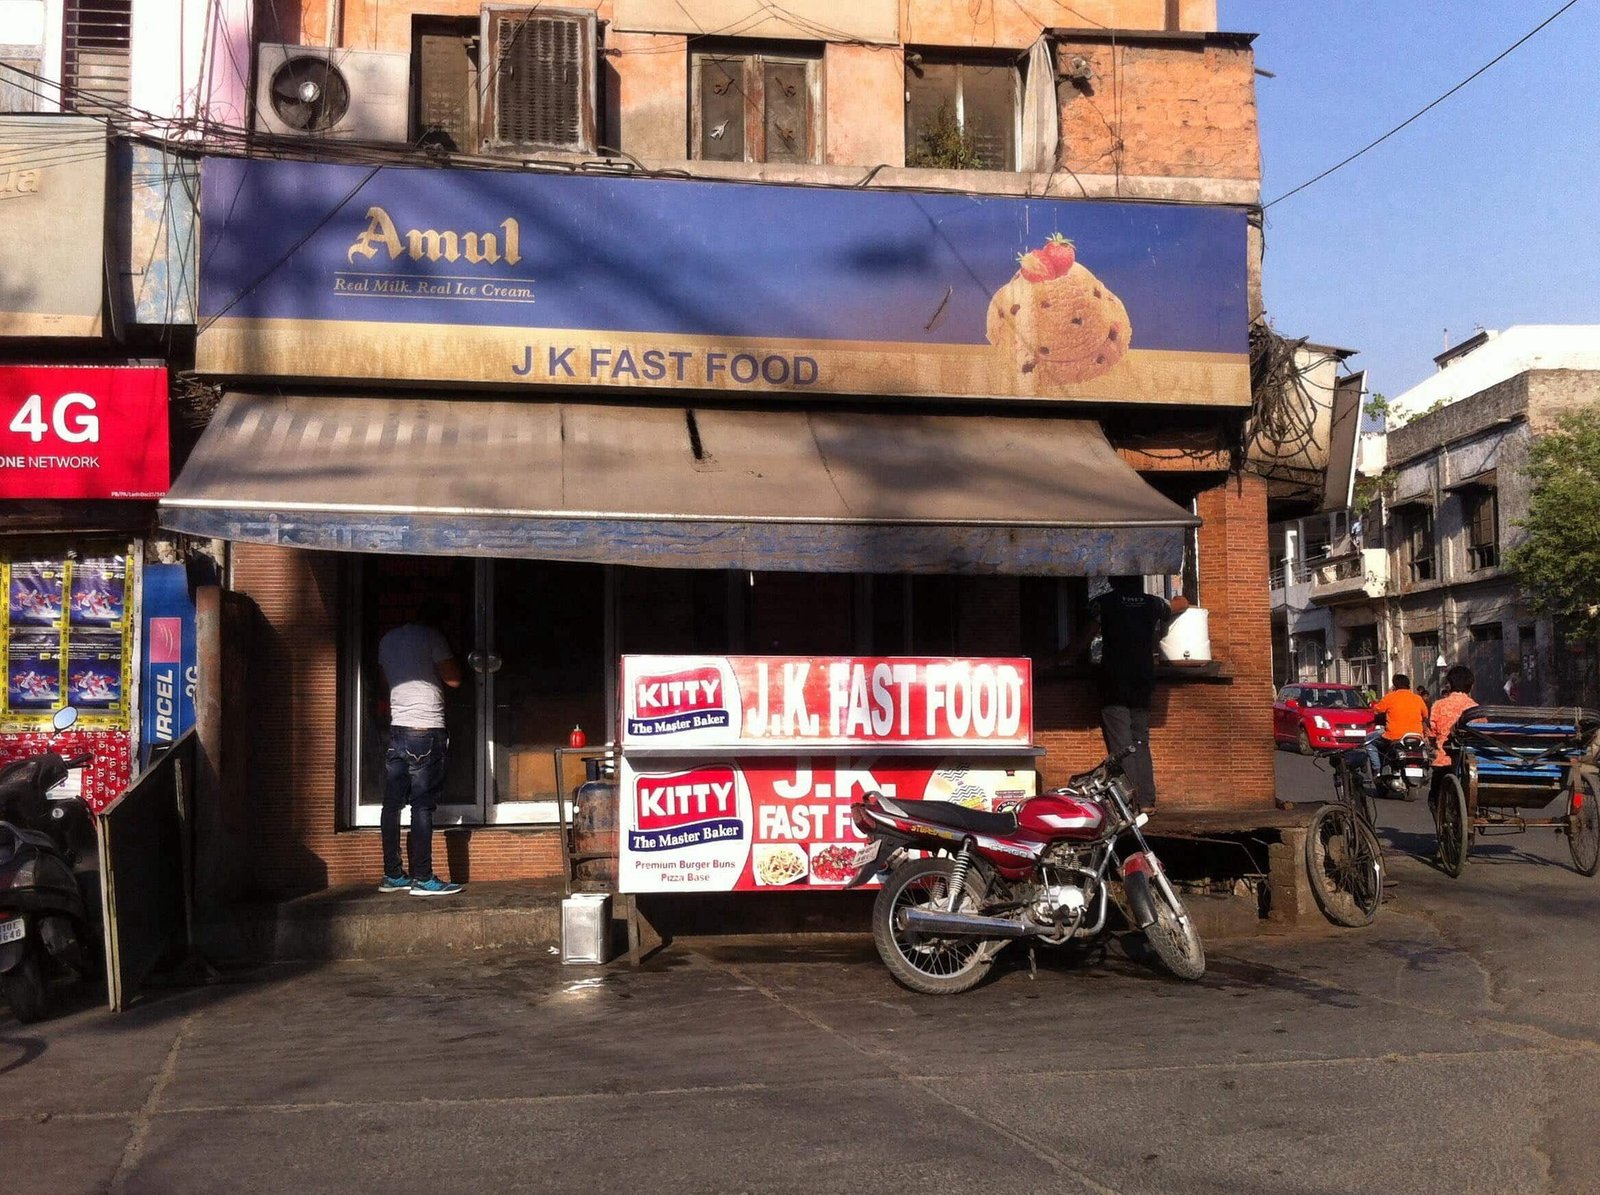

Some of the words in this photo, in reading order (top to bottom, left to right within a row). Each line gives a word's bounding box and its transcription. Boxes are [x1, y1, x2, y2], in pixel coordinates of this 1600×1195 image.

[348, 206, 522, 265] Amul
[333, 278, 369, 291] Real
[372, 279, 412, 292] Milk.
[416, 281, 451, 295] Real
[455, 283, 477, 295] Ice
[481, 284, 535, 298] Cream.
[512, 346, 532, 376] J
[549, 347, 576, 377] K
[590, 348, 692, 381] FAST
[706, 353, 819, 385] FOOD
[9, 392, 99, 443] 4G
[29, 456, 100, 468] NETWORK
[156, 669, 173, 750] IRCEL
[639, 679, 720, 708] KITTY
[746, 663, 820, 737] J.K.
[830, 663, 917, 737] FAST
[926, 661, 1023, 737] FOOD
[632, 722, 652, 735] The
[657, 717, 691, 733] Master
[693, 715, 726, 727] Baker
[640, 781, 733, 817] KITTY
[633, 835, 656, 849] The
[659, 830, 700, 847] Master
[703, 825, 739, 841] Baker
[759, 804, 830, 839] FAST
[635, 860, 677, 870] Premium
[679, 860, 711, 872] Burger
[713, 859, 736, 869] Buns
[661, 873, 685, 882] Pizza
[687, 873, 711, 882] Base
